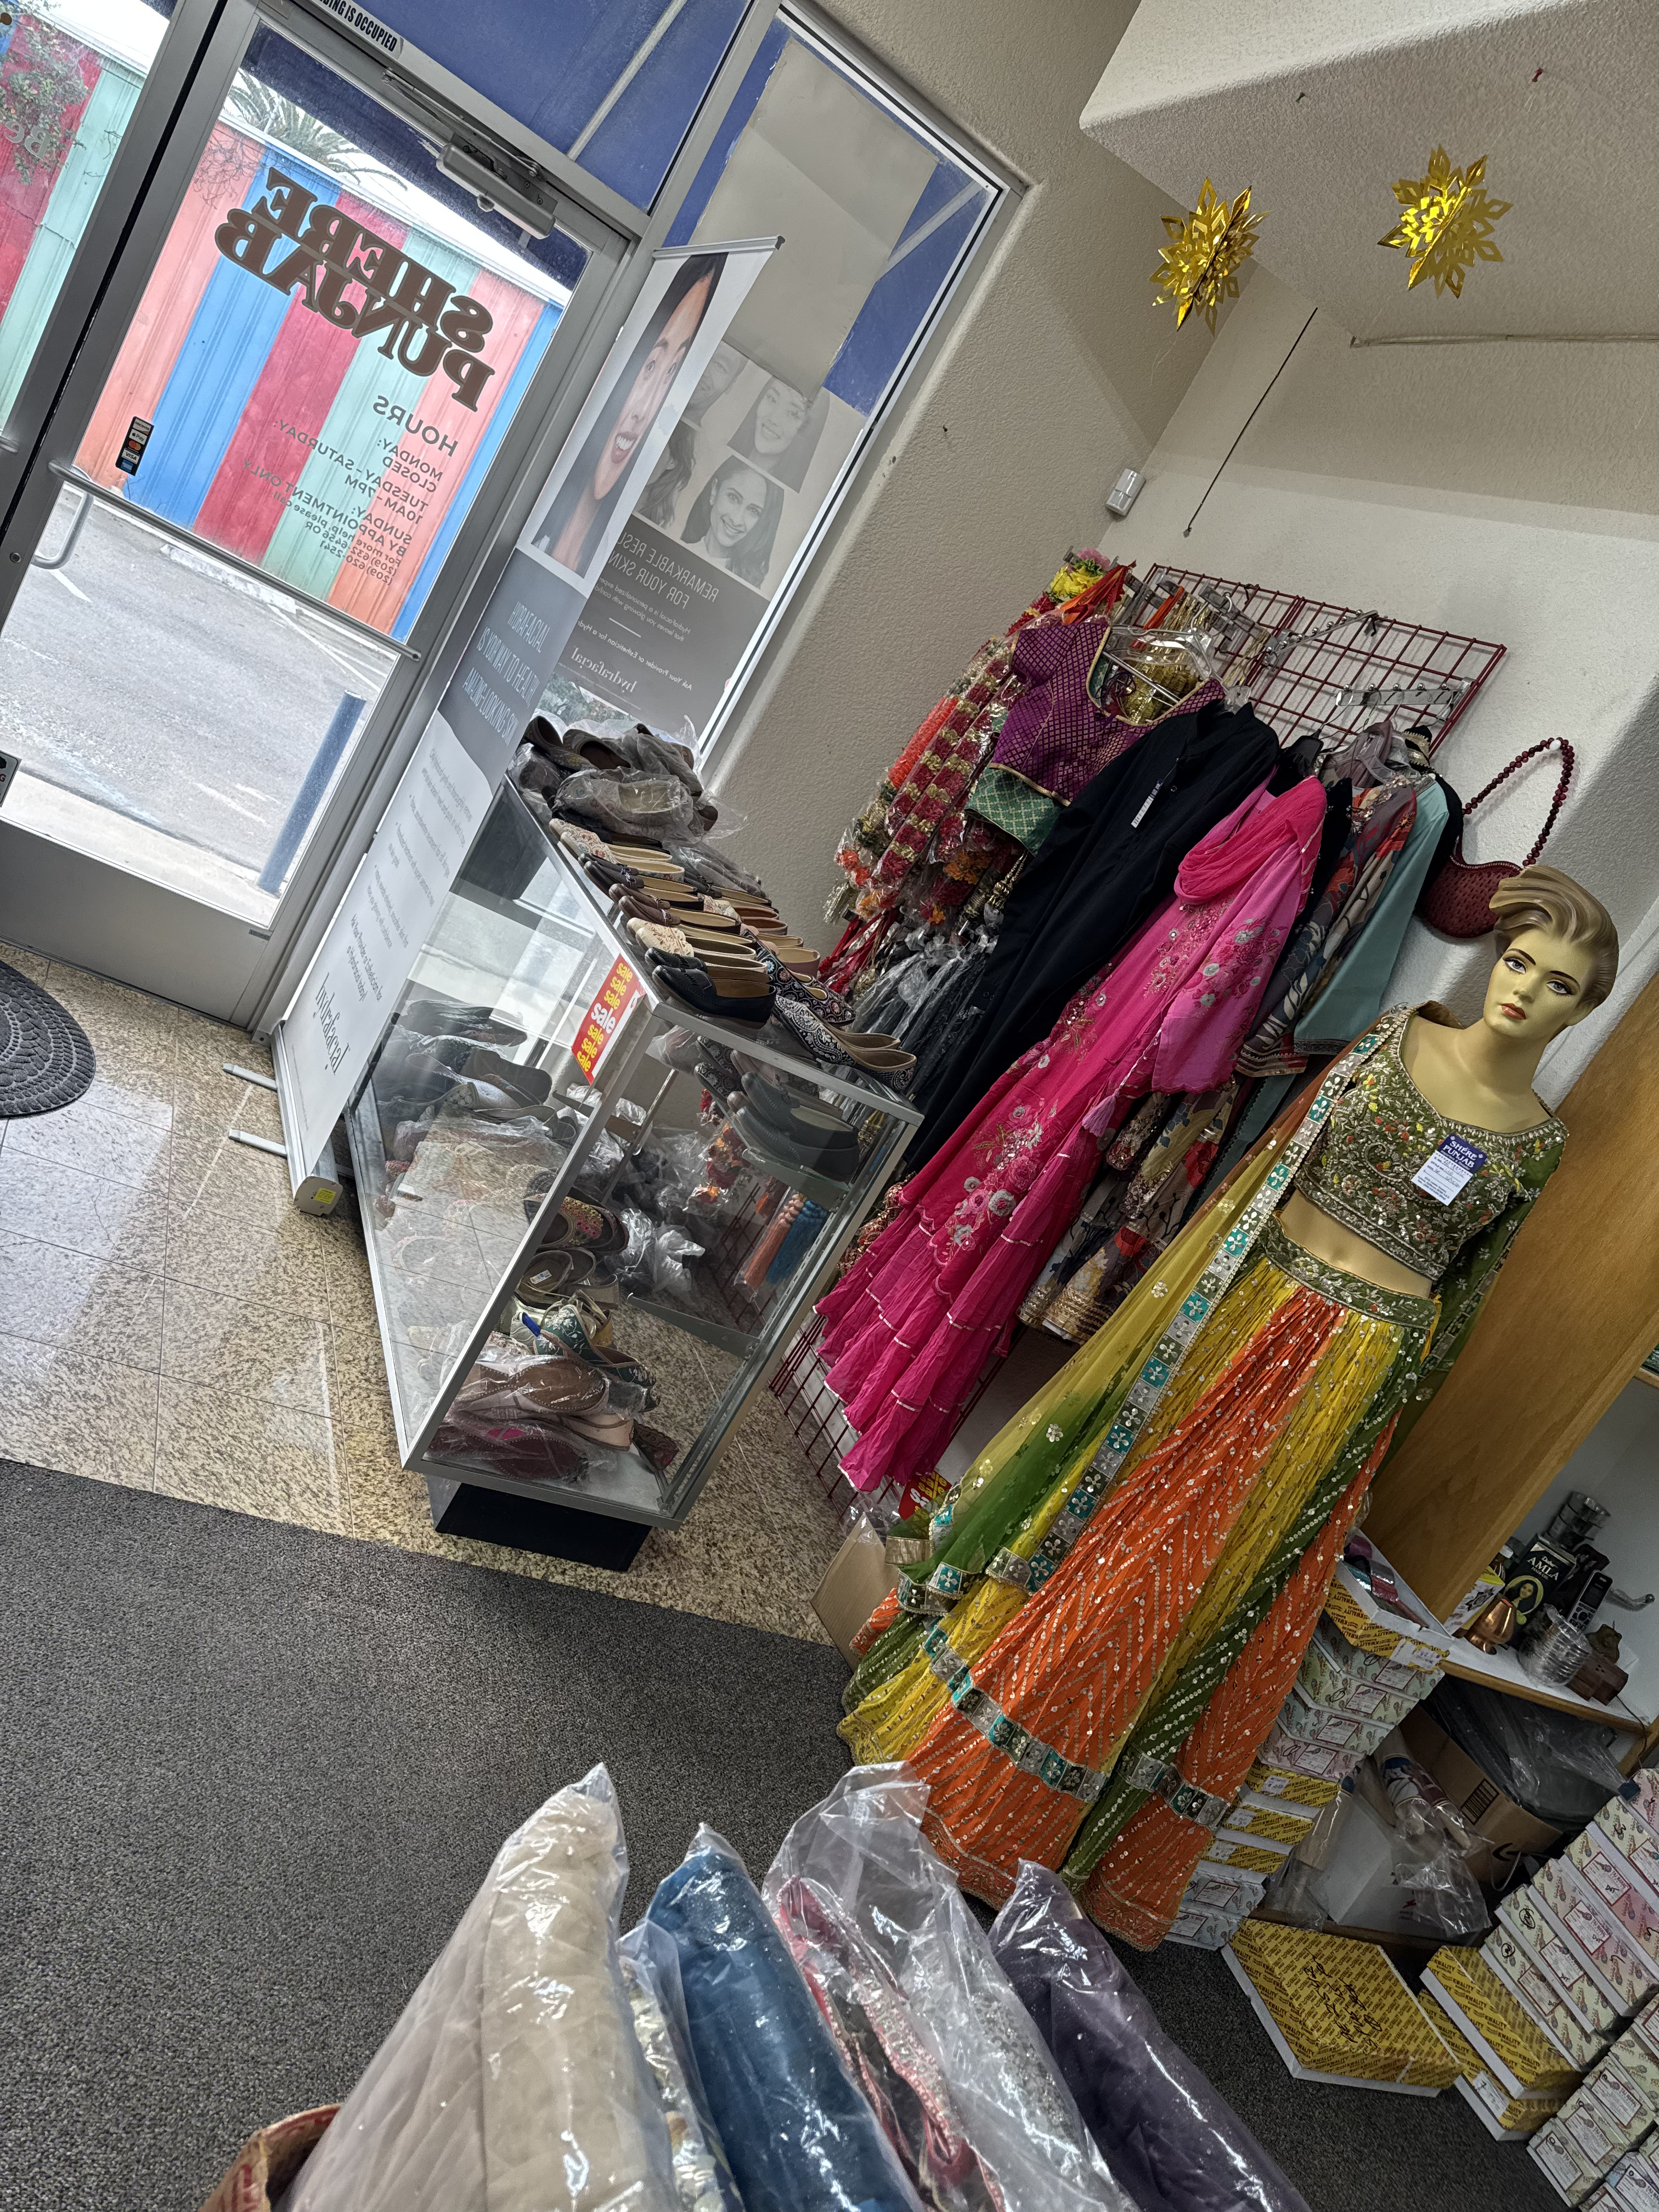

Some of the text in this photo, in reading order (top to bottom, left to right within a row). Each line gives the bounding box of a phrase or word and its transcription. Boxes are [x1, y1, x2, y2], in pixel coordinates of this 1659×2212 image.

[344, 5, 357, 22] IS
[354, 13, 397, 52] OCCUPIED
[135, 421, 150, 431] DISCOVER
[126, 452, 137, 461] VISA
[507, 601, 550, 653] HYDRAFACIAL
[477, 627, 490, 651] IS
[504, 654, 520, 682] TO
[501, 713, 519, 746] SKIN
[617, 963, 633, 982] sale
[611, 977, 627, 996] sale
[604, 990, 620, 1009] sale
[313, 972, 349, 1075] hydrafacial
[591, 1003, 616, 1034] sale
[588, 1024, 603, 1045] sale
[582, 1037, 597, 1058] sale
[577, 1051, 591, 1071] sale
[1442, 1144, 1475, 1167] PUNJAB
[1450, 1140, 1477, 1160] SHERE
[1526, 1555, 1559, 1581] AMLA
[1616, 1876, 1627, 1889] MAHAL
[1234, 1948, 1251, 1960] KWALITY
[1243, 1964, 1261, 1976] KWALITY
[1435, 1959, 1455, 1971] KWALITY
[1259, 1984, 1277, 1997] KWALITY
[1453, 1979, 1474, 1991] KWALITY
[1268, 2002, 1287, 2015] KWALITY
[1465, 1994, 1487, 2008] KWALITY
[1485, 2015, 1507, 2028] KWALITY
[1284, 2023, 1305, 2038] KWALITY
[1486, 2037, 1504, 2050] WALITY
[1498, 2032, 1520, 2045] KWALITY
[1295, 2043, 1314, 2056] KWALITY
[1499, 2056, 1517, 2067] WALITY
[1519, 2054, 1541, 2067] KWALITY
[1618, 2087, 1639, 2108] TAJ MAHAL
